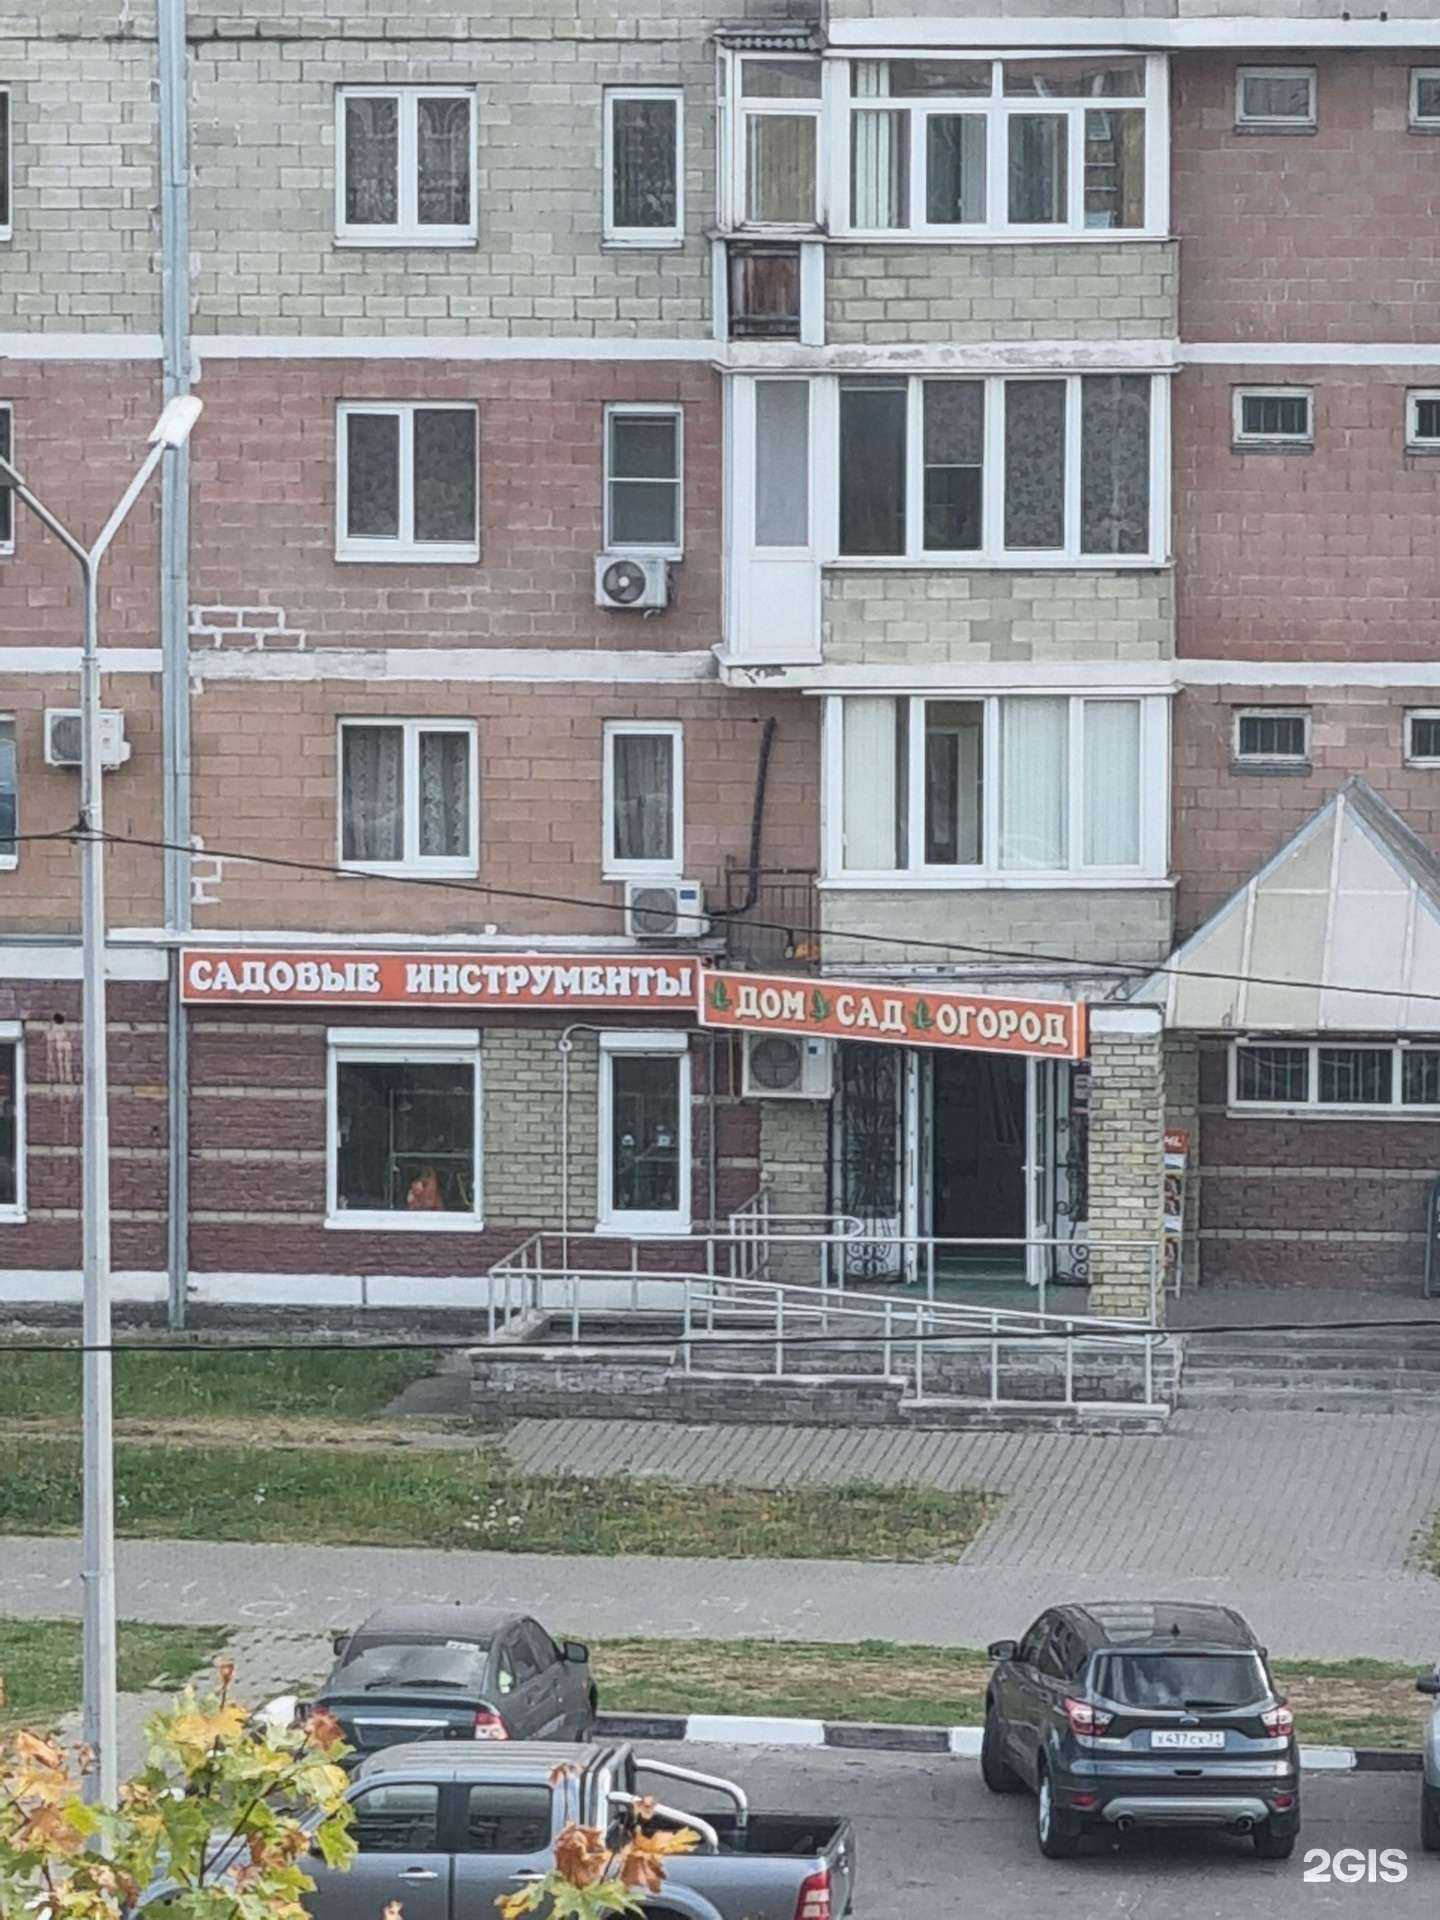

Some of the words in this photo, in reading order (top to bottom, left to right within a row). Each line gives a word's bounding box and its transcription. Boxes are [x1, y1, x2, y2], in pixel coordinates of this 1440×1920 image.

[189, 960, 381, 993] САДОВЫЕ
[405, 963, 693, 997] ИНСТРУМЕНТЫ
[734, 985, 806, 1020] ДОМ
[835, 994, 907, 1033] САД
[935, 1003, 1069, 1047] ОГОРОД
